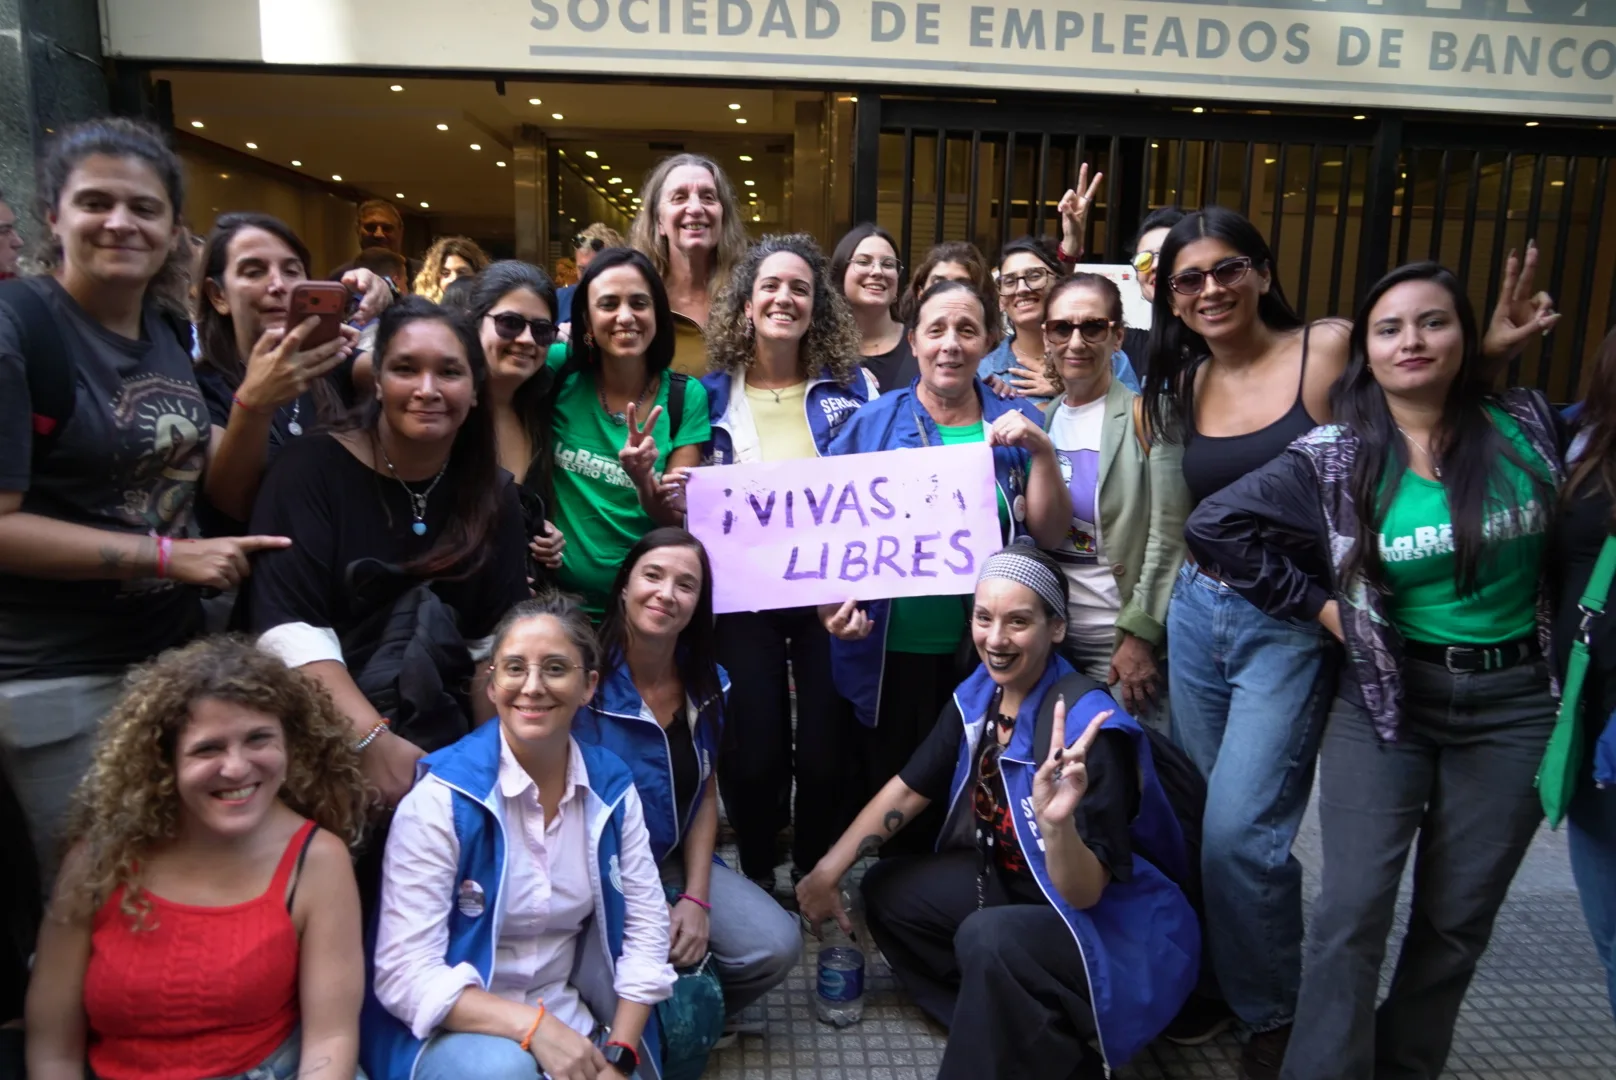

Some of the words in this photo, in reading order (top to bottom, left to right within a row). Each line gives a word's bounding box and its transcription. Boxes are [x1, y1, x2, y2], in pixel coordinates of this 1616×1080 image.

[529, 0, 840, 40] SOCIEDAD
[870, 1, 940, 45] DE
[969, 6, 1311, 65] EMPLEADOS
[1336, 26, 1404, 68] DE
[1428, 31, 1616, 80] BANCO
[783, 529, 975, 581] LIBRES
[1381, 541, 1455, 563] NUESTR
